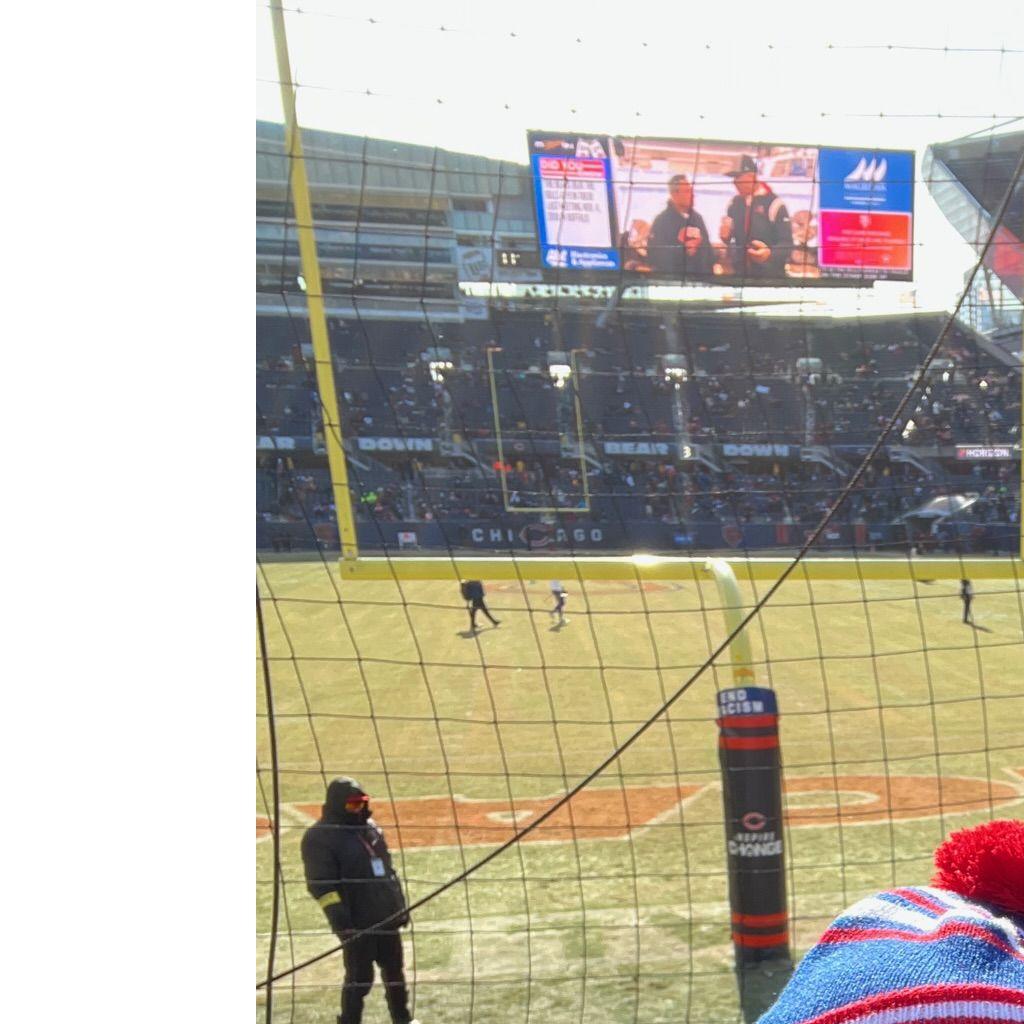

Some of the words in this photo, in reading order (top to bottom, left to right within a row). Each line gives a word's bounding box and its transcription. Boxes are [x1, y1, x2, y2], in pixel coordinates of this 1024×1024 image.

[358, 437, 433, 450] DOWN
[604, 442, 668, 455] BEAR
[720, 689, 747, 704] END
